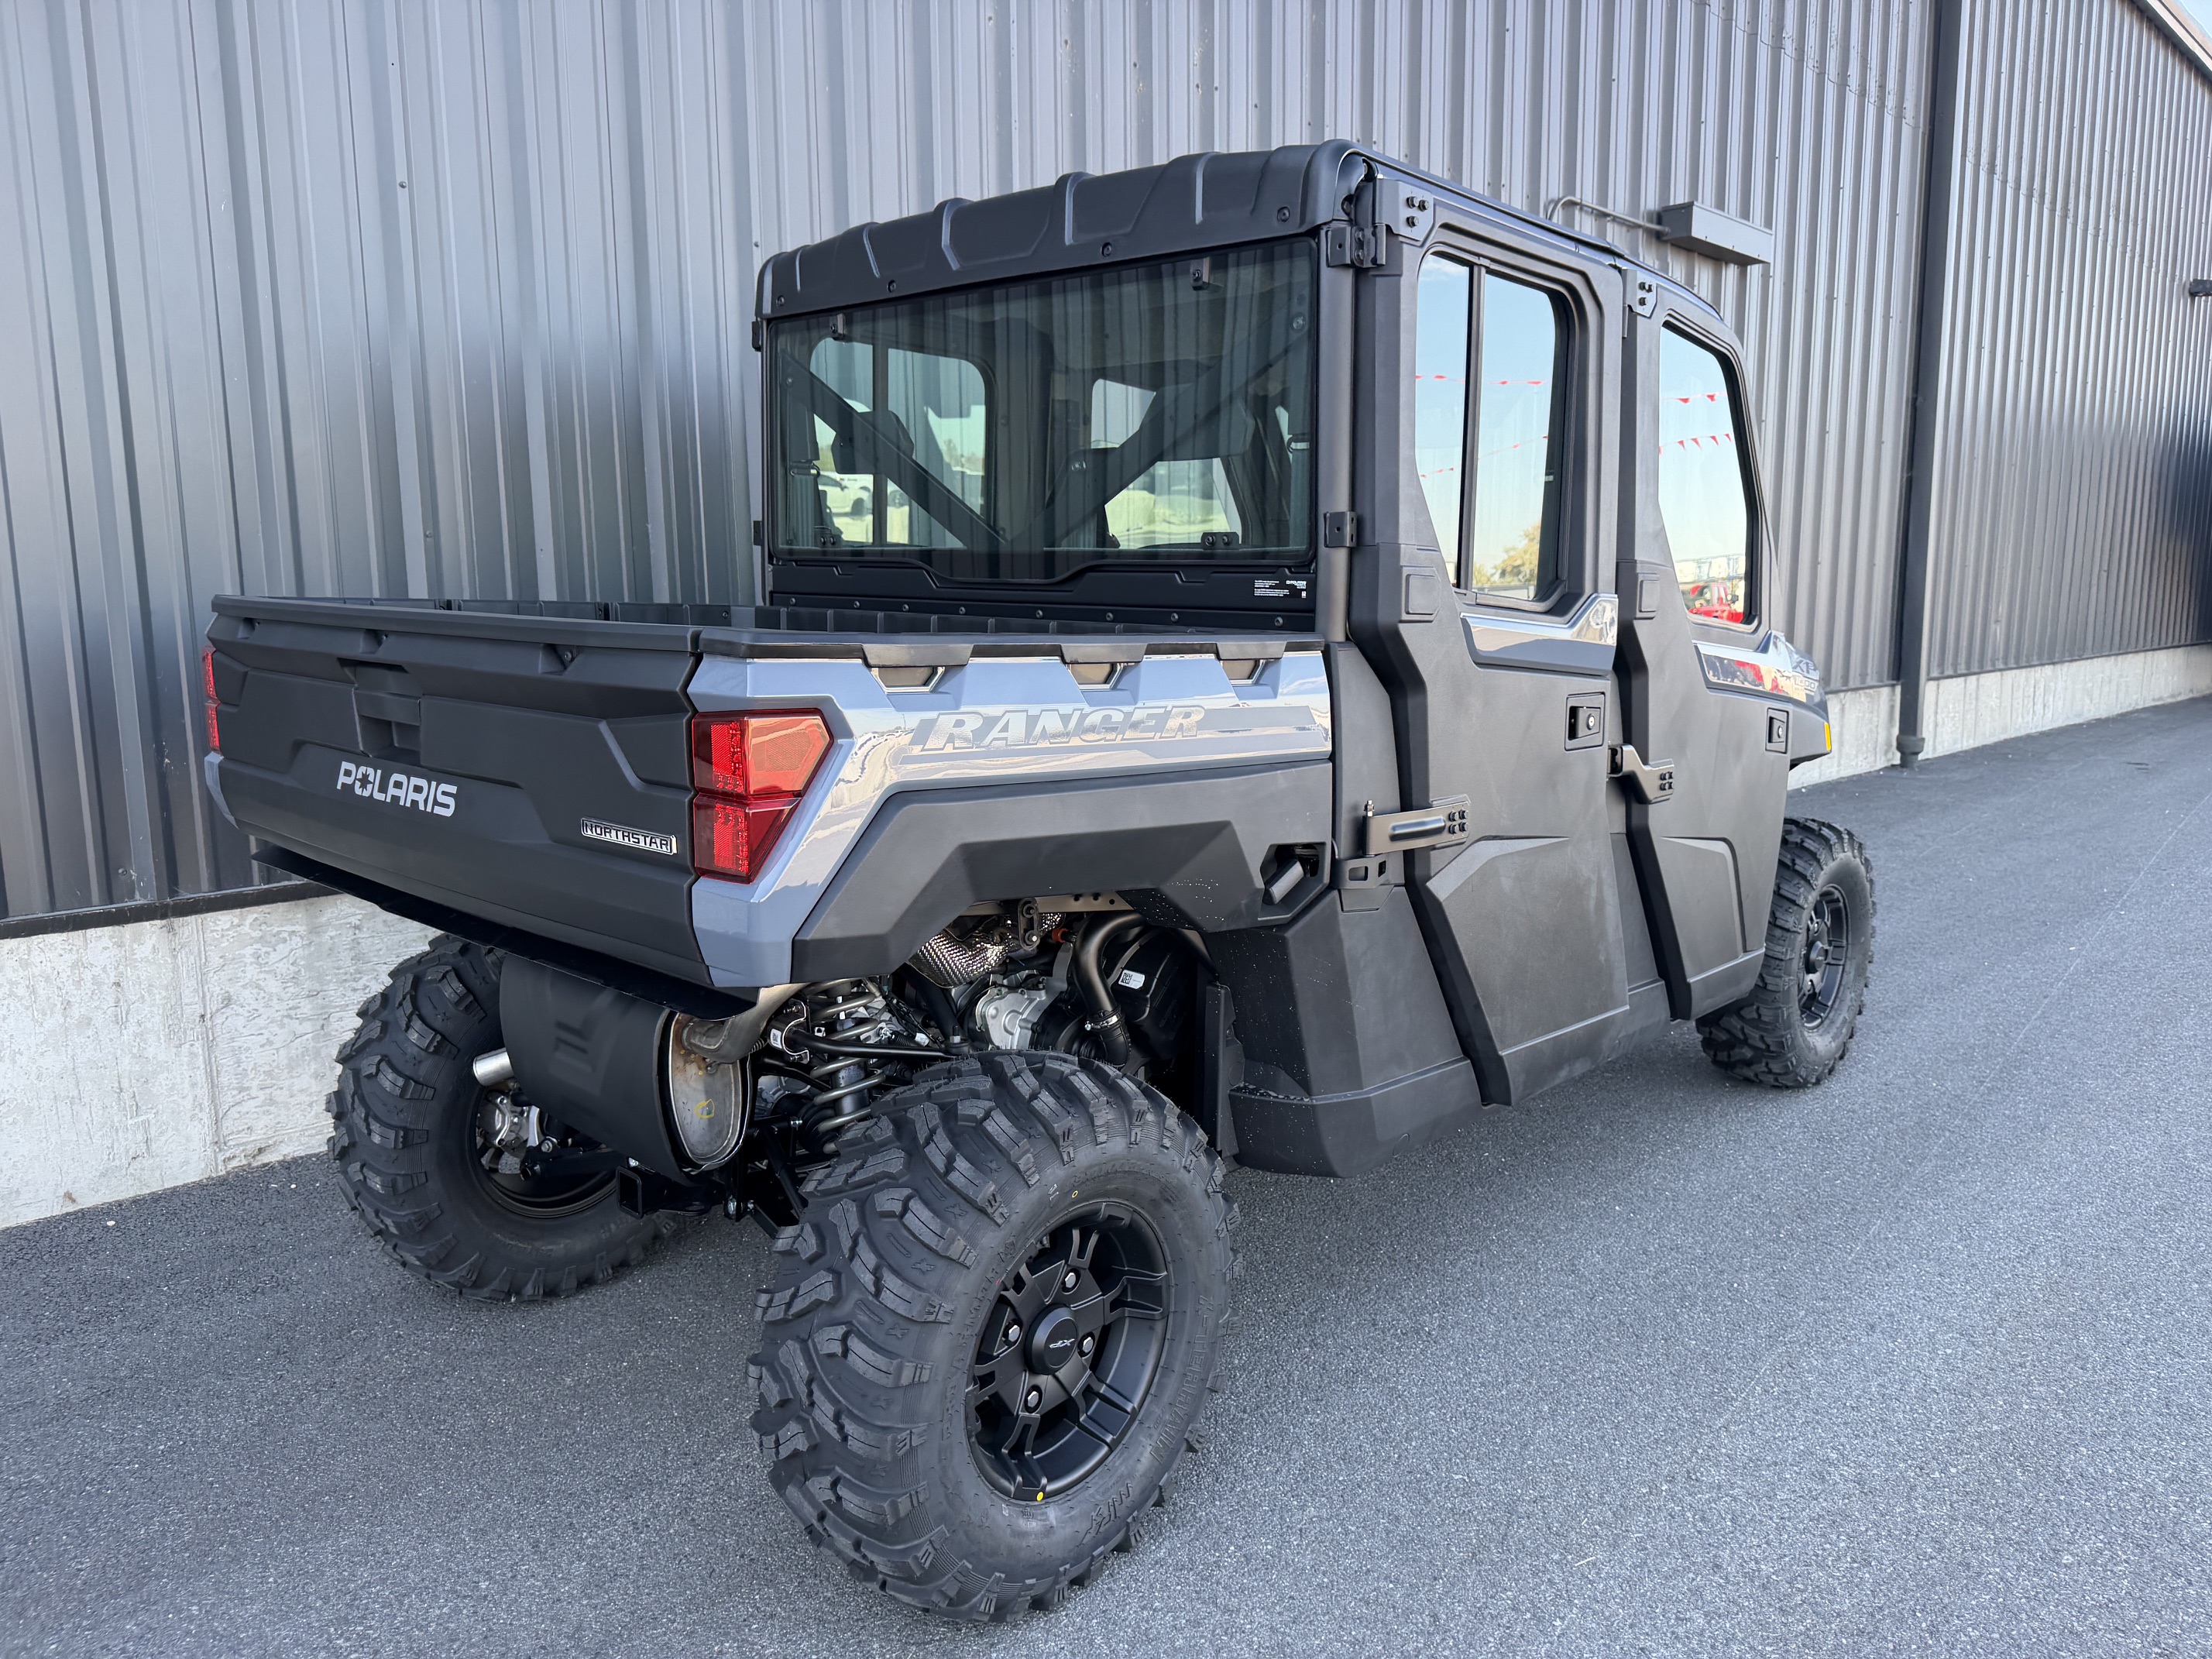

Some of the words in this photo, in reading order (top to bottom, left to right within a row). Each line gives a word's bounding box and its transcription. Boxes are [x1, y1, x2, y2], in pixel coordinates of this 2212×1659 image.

[922, 706, 1205, 750] RANGER
[336, 761, 458, 817] POLARIS
[583, 820, 670, 850] NORTHSTAR
